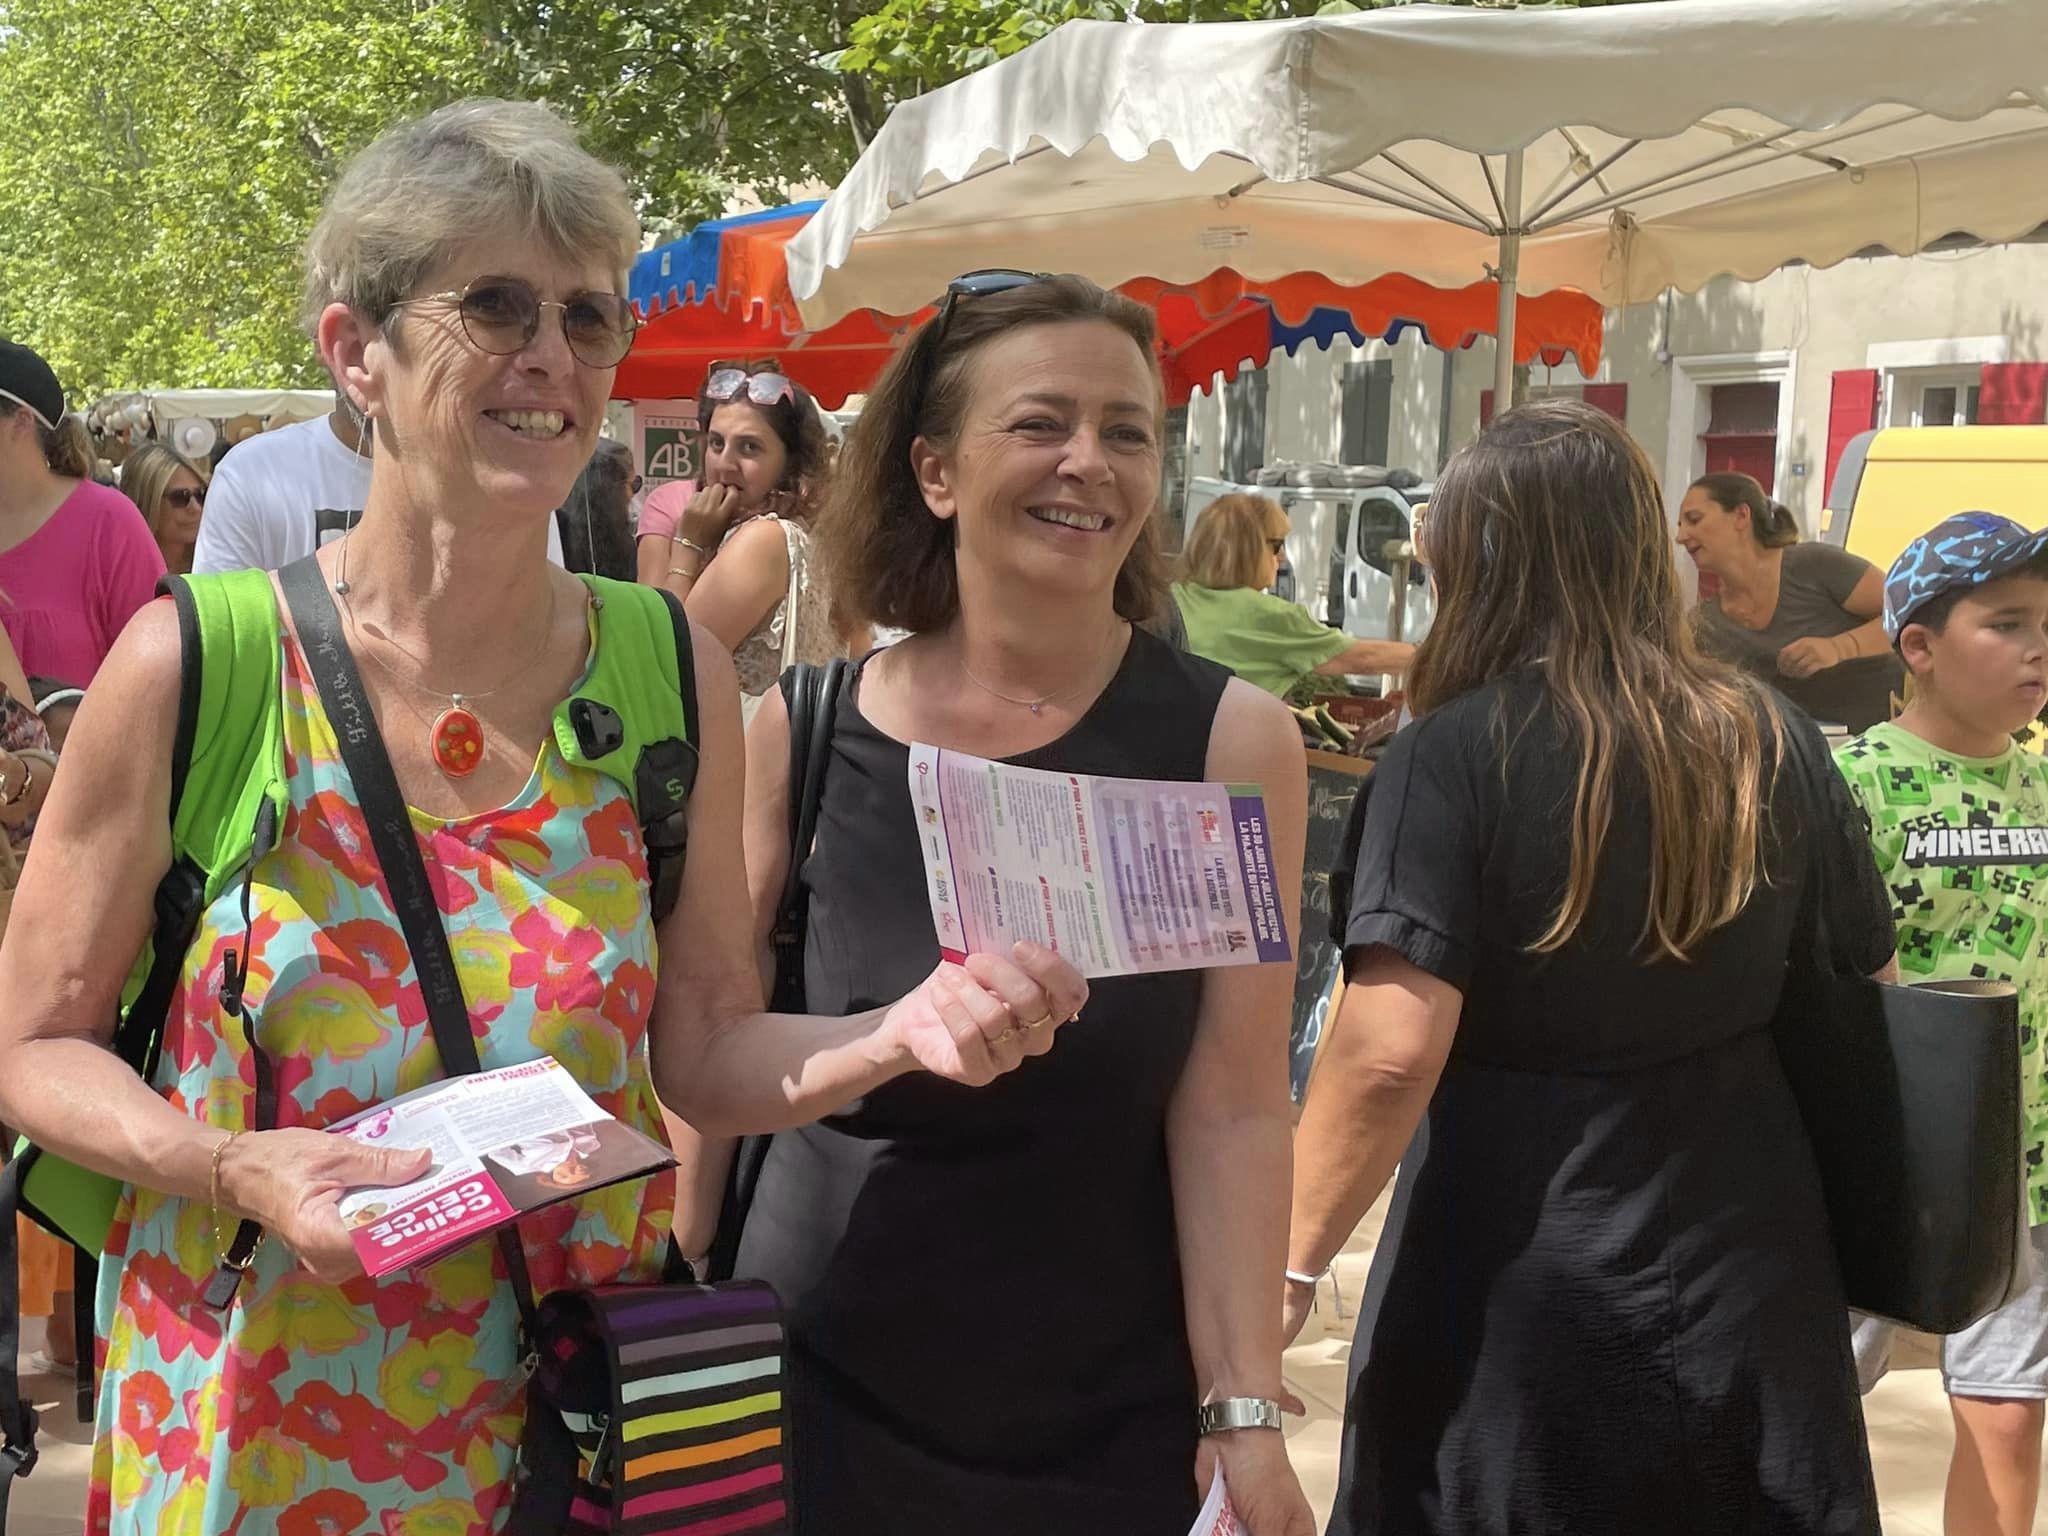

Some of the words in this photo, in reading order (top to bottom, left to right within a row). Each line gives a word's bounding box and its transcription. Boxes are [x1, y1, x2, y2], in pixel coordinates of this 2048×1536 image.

[648, 442, 692, 477] AB
[1251, 817, 1261, 834] LES
[1256, 844, 1266, 863] JUIN
[1903, 827, 2048, 862] MINECRA
[1239, 820, 1249, 833] LA
[1251, 883, 1262, 907] FRONT
[1259, 863, 1268, 874] ET
[368, 1181, 484, 1245] CELCE
[381, 1194, 493, 1248] Céline
